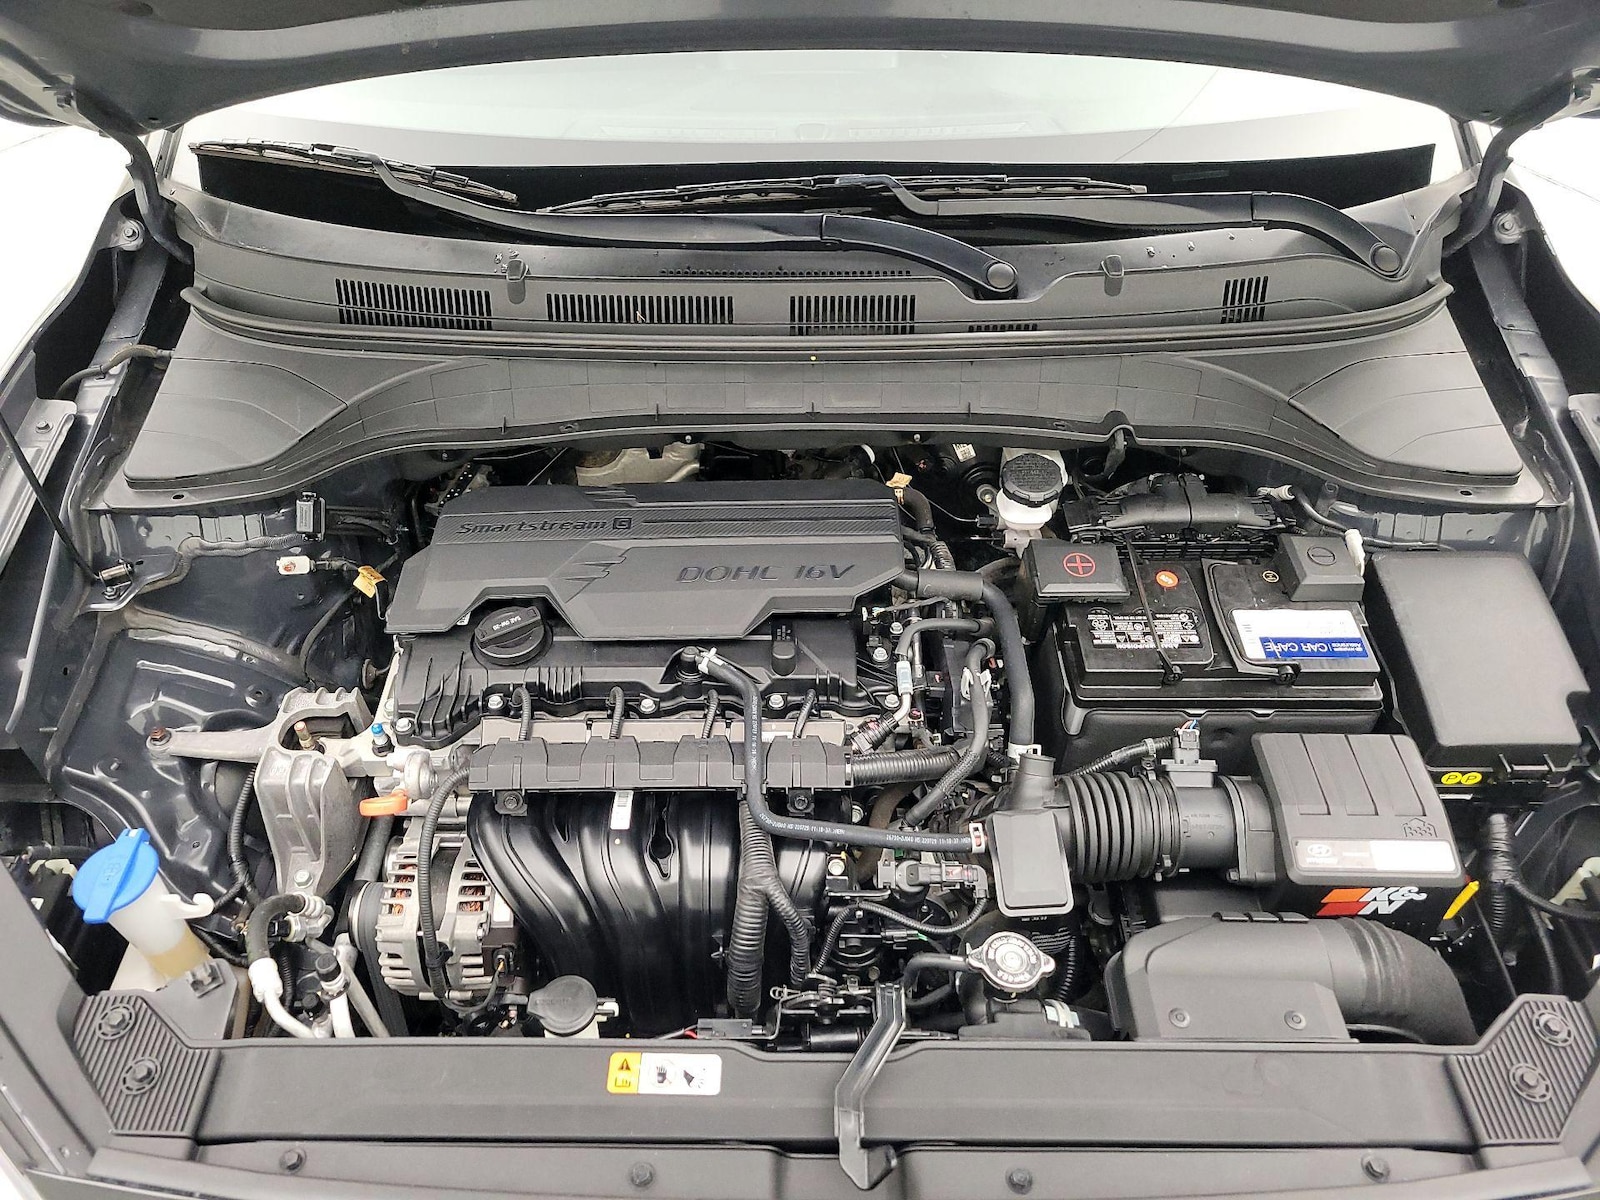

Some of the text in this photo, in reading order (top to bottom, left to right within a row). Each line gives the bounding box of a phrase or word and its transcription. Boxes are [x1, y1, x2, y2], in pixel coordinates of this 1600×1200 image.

[456, 520, 607, 534] Smartstream
[676, 563, 856, 583] DOHC 16V
[1263, 642, 1298, 652] CARE
[1301, 642, 1327, 652] CAR
[1357, 886, 1428, 915] K&N
